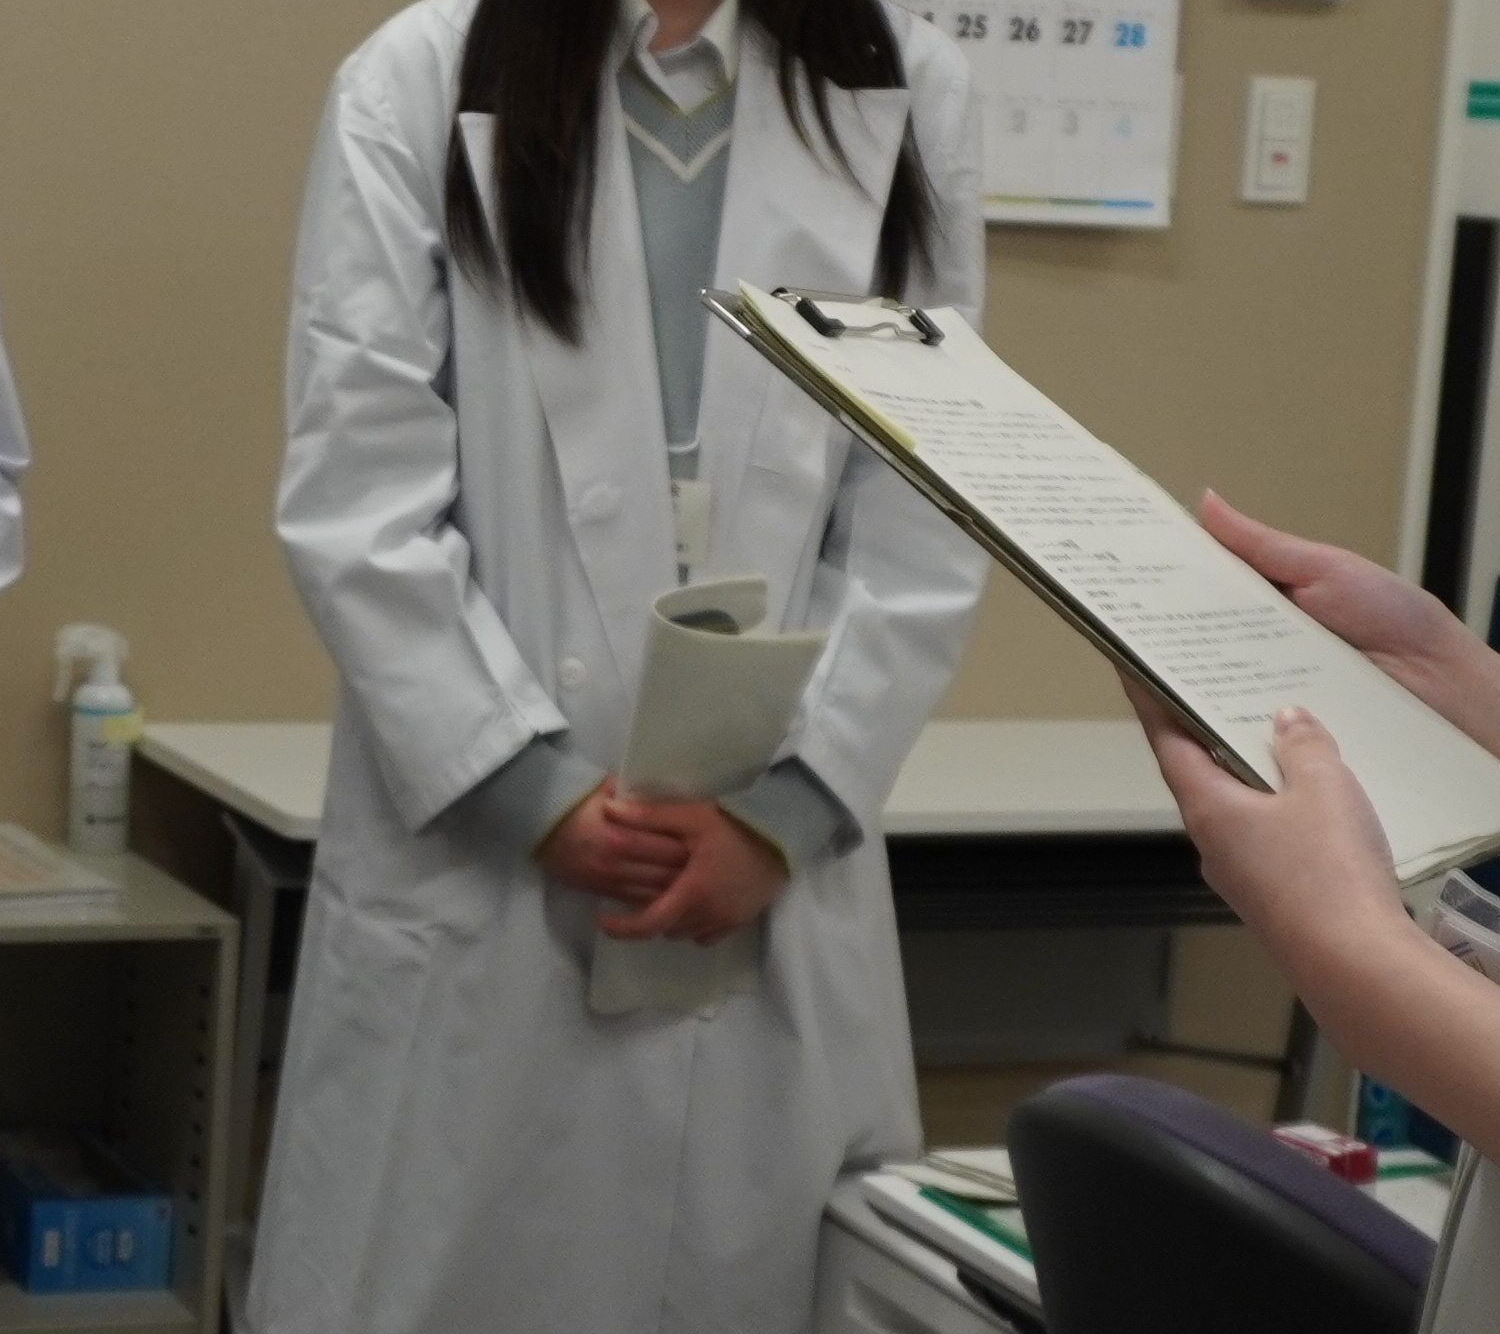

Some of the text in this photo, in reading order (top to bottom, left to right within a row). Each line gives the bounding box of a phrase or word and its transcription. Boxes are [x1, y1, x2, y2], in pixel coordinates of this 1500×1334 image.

[956, 14, 988, 40] 25
[1009, 16, 1041, 42] 26
[1062, 19, 1094, 45] 27
[1115, 22, 1146, 48] 28
[1009, 108, 1028, 135] 2
[1063, 112, 1080, 137] 3
